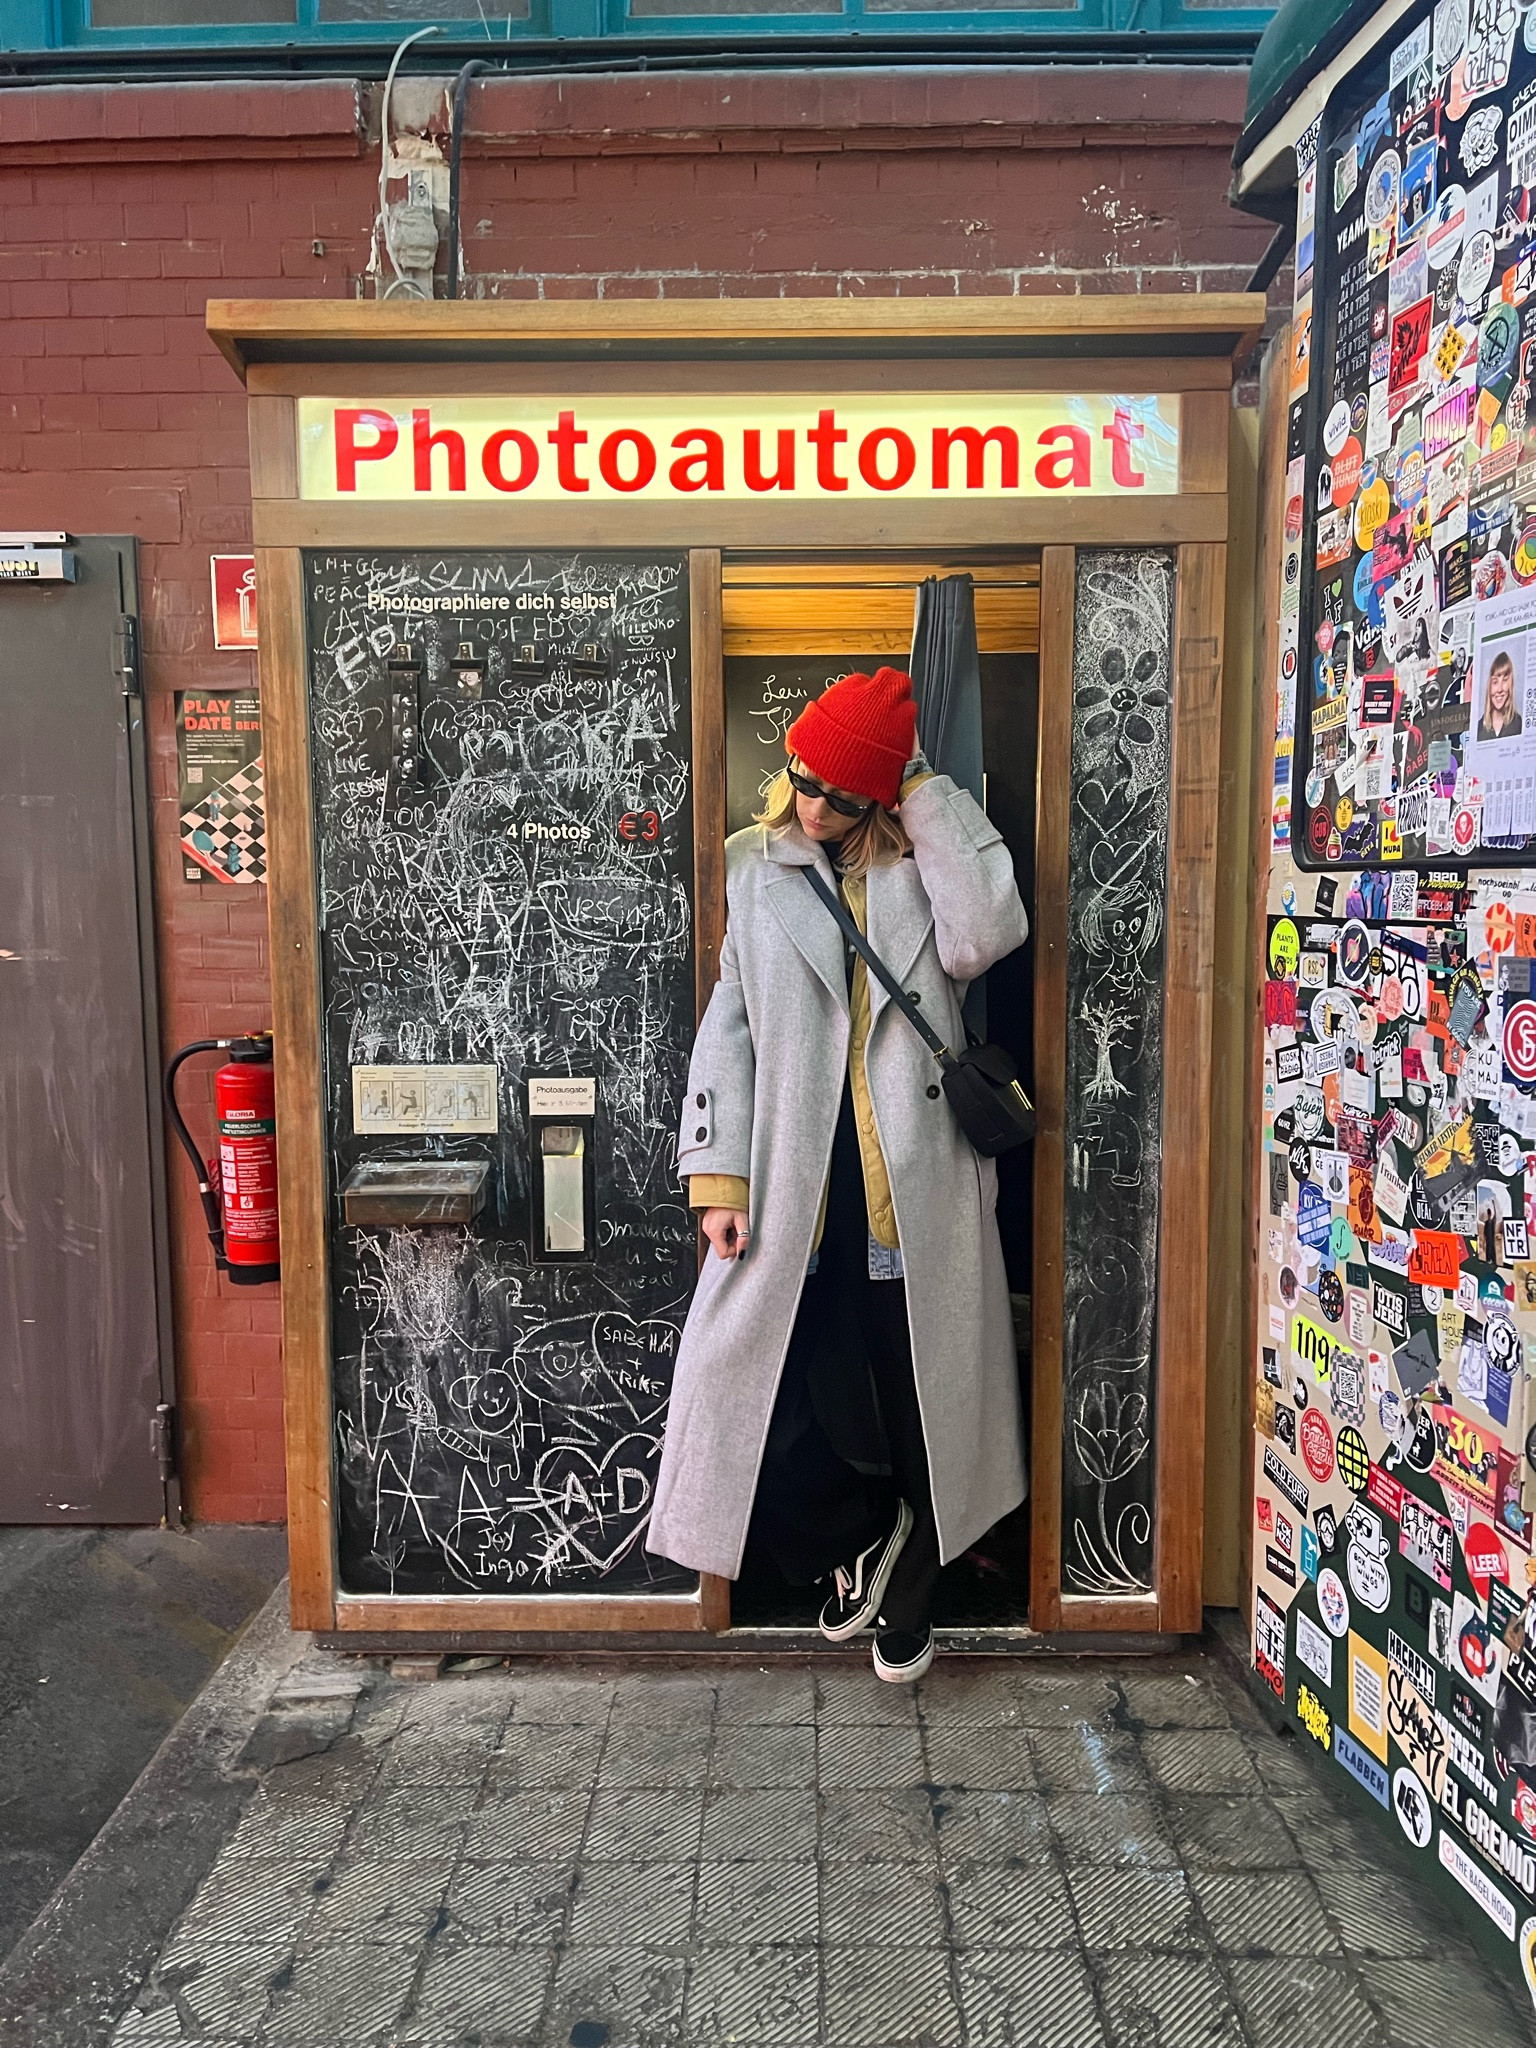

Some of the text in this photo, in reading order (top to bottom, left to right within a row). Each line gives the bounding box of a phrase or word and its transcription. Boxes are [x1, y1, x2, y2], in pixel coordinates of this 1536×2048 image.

[1328, 412, 1347, 438] vivid
[334, 408, 1145, 493] Photoautomat
[367, 592, 617, 613] Photographiere dich selbst
[184, 700, 231, 714] PLAY
[185, 716, 260, 731] DATE BER
[507, 822, 591, 840] 4 Photos
[1428, 871, 1459, 881] 1920
[1276, 933, 1294, 944] PLANTS
[1279, 945, 1289, 953] ARE
[1461, 982, 1473, 997] YOU
[1280, 1050, 1299, 1063] KIOSK
[1478, 1053, 1493, 1066] KU
[1477, 1071, 1499, 1085] MAJ
[536, 1086, 588, 1095] Photoausgabe
[1506, 1223, 1523, 1237] NF
[1508, 1240, 1525, 1253] TR
[1375, 1305, 1404, 1334] JERK
[1441, 1312, 1457, 1324] ART
[1447, 1416, 1484, 1465] 30
[1265, 1451, 1308, 1503] COLD FURY
[1459, 1484, 1495, 1513] ZUKUNFT
[1277, 1517, 1292, 1536] FCK
[1276, 1530, 1291, 1551] NZS
[1471, 1553, 1502, 1573] LEER
[1356, 1565, 1379, 1589] WINGS
[1256, 1628, 1285, 1674] VILLE
[1270, 1630, 1285, 1653] LA
[1338, 1742, 1385, 1796] FLABBEN
[1442, 1775, 1463, 1822] EL
[1465, 1797, 1536, 1895] GREMIO
[1456, 1853, 1512, 1928] THE BAGEL HOOD
